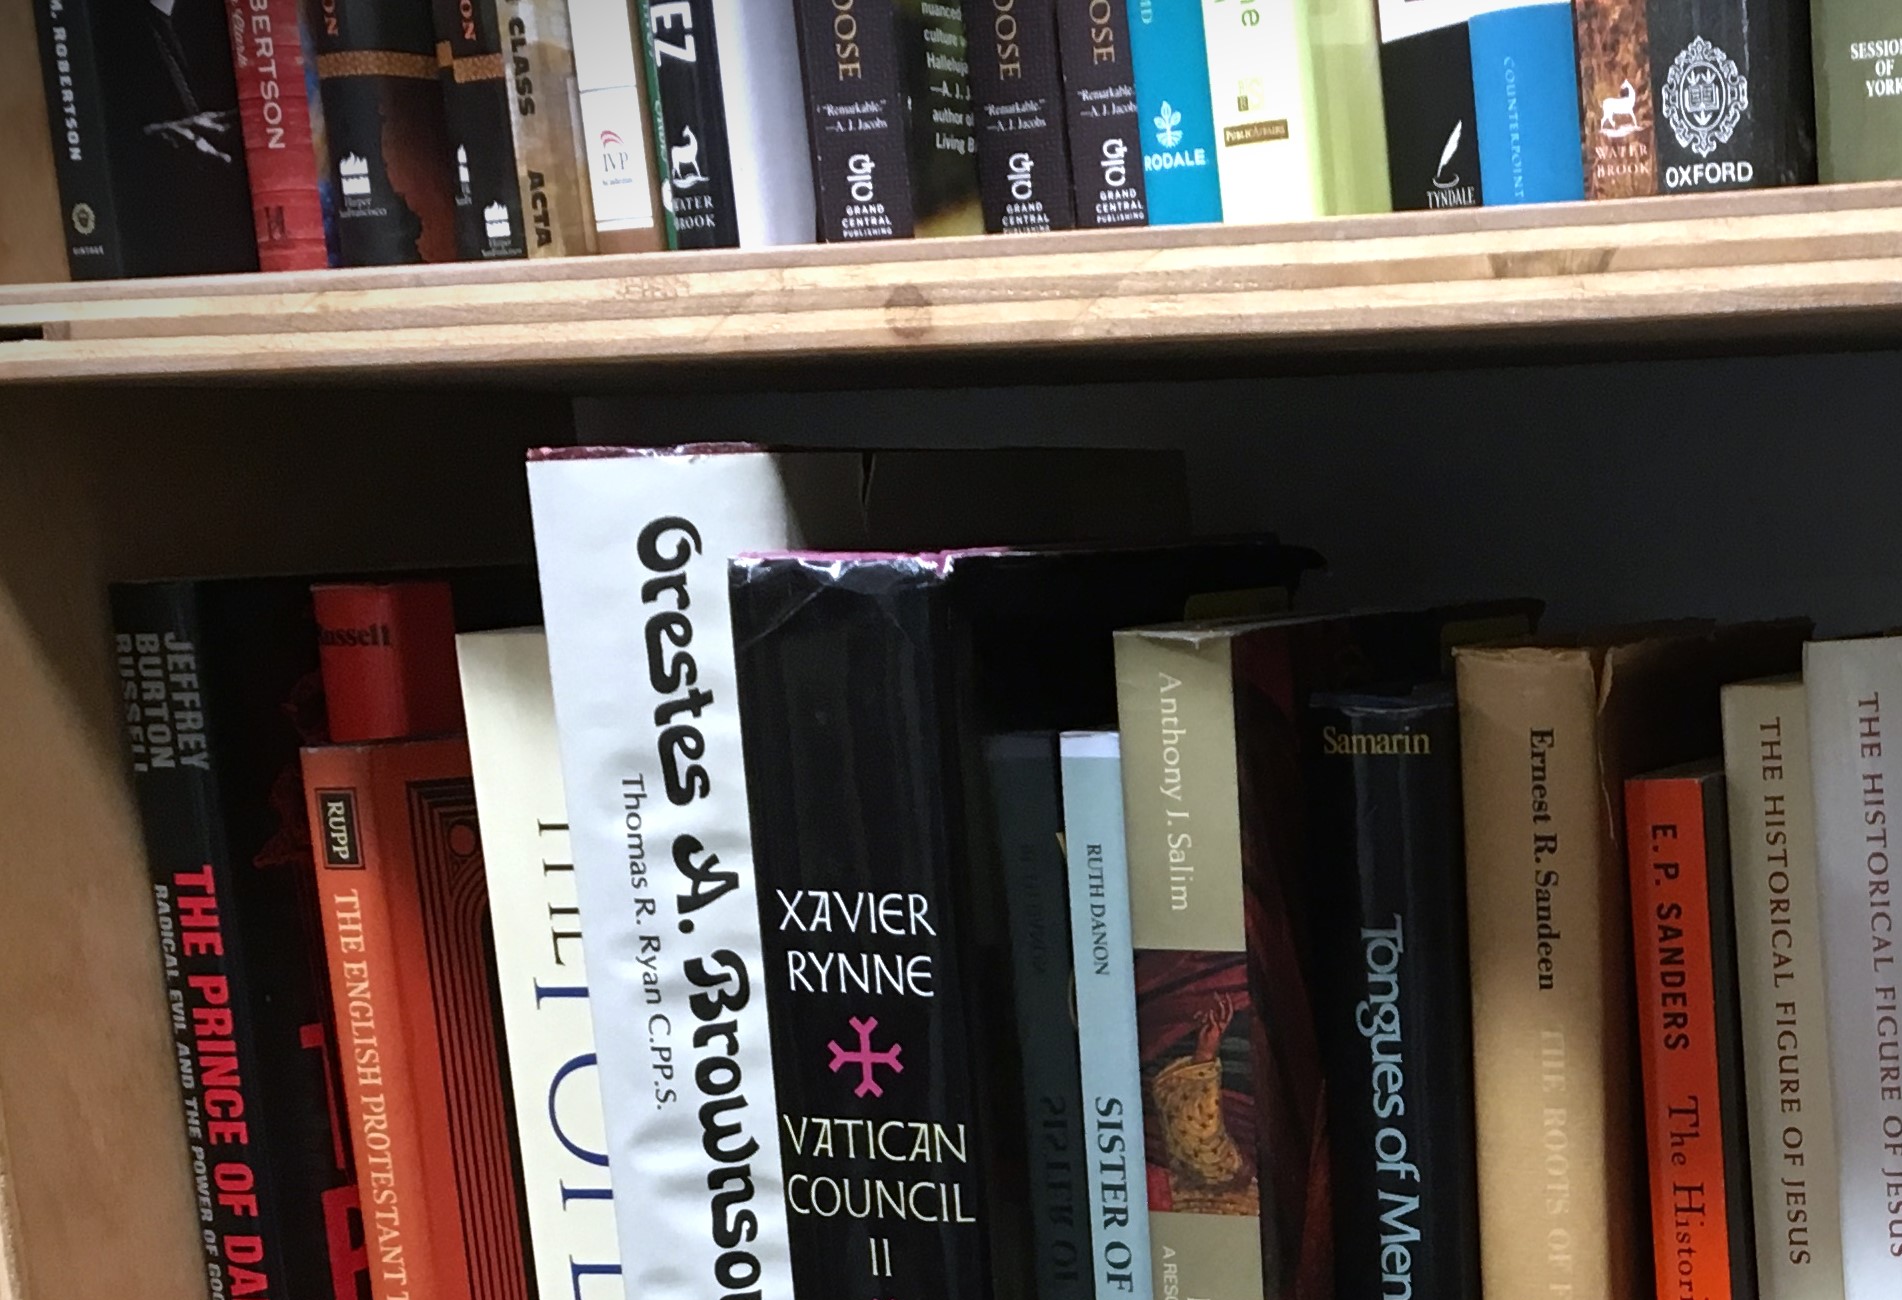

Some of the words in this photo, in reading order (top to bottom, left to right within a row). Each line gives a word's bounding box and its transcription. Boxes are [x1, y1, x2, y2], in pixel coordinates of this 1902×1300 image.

[53, 26, 82, 161] ROBERTSON
[508, 16, 535, 117] CLASS
[1875, 58, 1896, 77] OF
[1144, 148, 1205, 171] RODALE
[1503, 55, 1525, 199] COUNTERPOINT
[1595, 142, 1649, 162] WATER
[603, 152, 628, 172] IVP
[1100, 188, 1136, 200] GRAND
[1598, 160, 1651, 180] BROOK
[1666, 161, 1754, 189] OXFORD
[527, 170, 552, 247] ACTA
[842, 214, 892, 228] CENTRAL
[846, 203, 885, 215] GRAND
[1095, 201, 1143, 214] CENTRAL
[1426, 186, 1474, 209] TYNDALE
[135, 633, 176, 769] BURTON
[1159, 673, 1186, 801] Anthony
[1323, 726, 1430, 756] Samarin
[1760, 717, 1783, 782] THE
[1530, 728, 1555, 826] Ernest
[327, 801, 349, 861] RUPP
[1086, 844, 1105, 898] RUTH
[1167, 831, 1193, 911] Salim
[1764, 794, 1794, 988] HISTORICAL
[173, 865, 223, 957] THE
[334, 889, 366, 954] THE
[775, 888, 937, 938] XAVIER
[1089, 904, 1111, 976] DANON
[1534, 869, 1560, 992] Sandeen
[639, 934, 662, 1006] Ryan
[786, 951, 935, 997] RYNNE
[1656, 902, 1689, 1052] SANDERS
[344, 961, 383, 1087] ENGLISH
[1355, 915, 1404, 1119] Tongues
[188, 974, 244, 1145] PRINCE
[1774, 1001, 1801, 1114] FIGURE
[781, 1113, 967, 1164] VATICAN
[1093, 1096, 1128, 1231] SISTER
[1782, 1126, 1805, 1165] OF
[212, 1162, 258, 1219] OF
[361, 1094, 407, 1287] PROTESTANT
[787, 1174, 976, 1224] COUNCIL
[1104, 1243, 1134, 1293] OF
